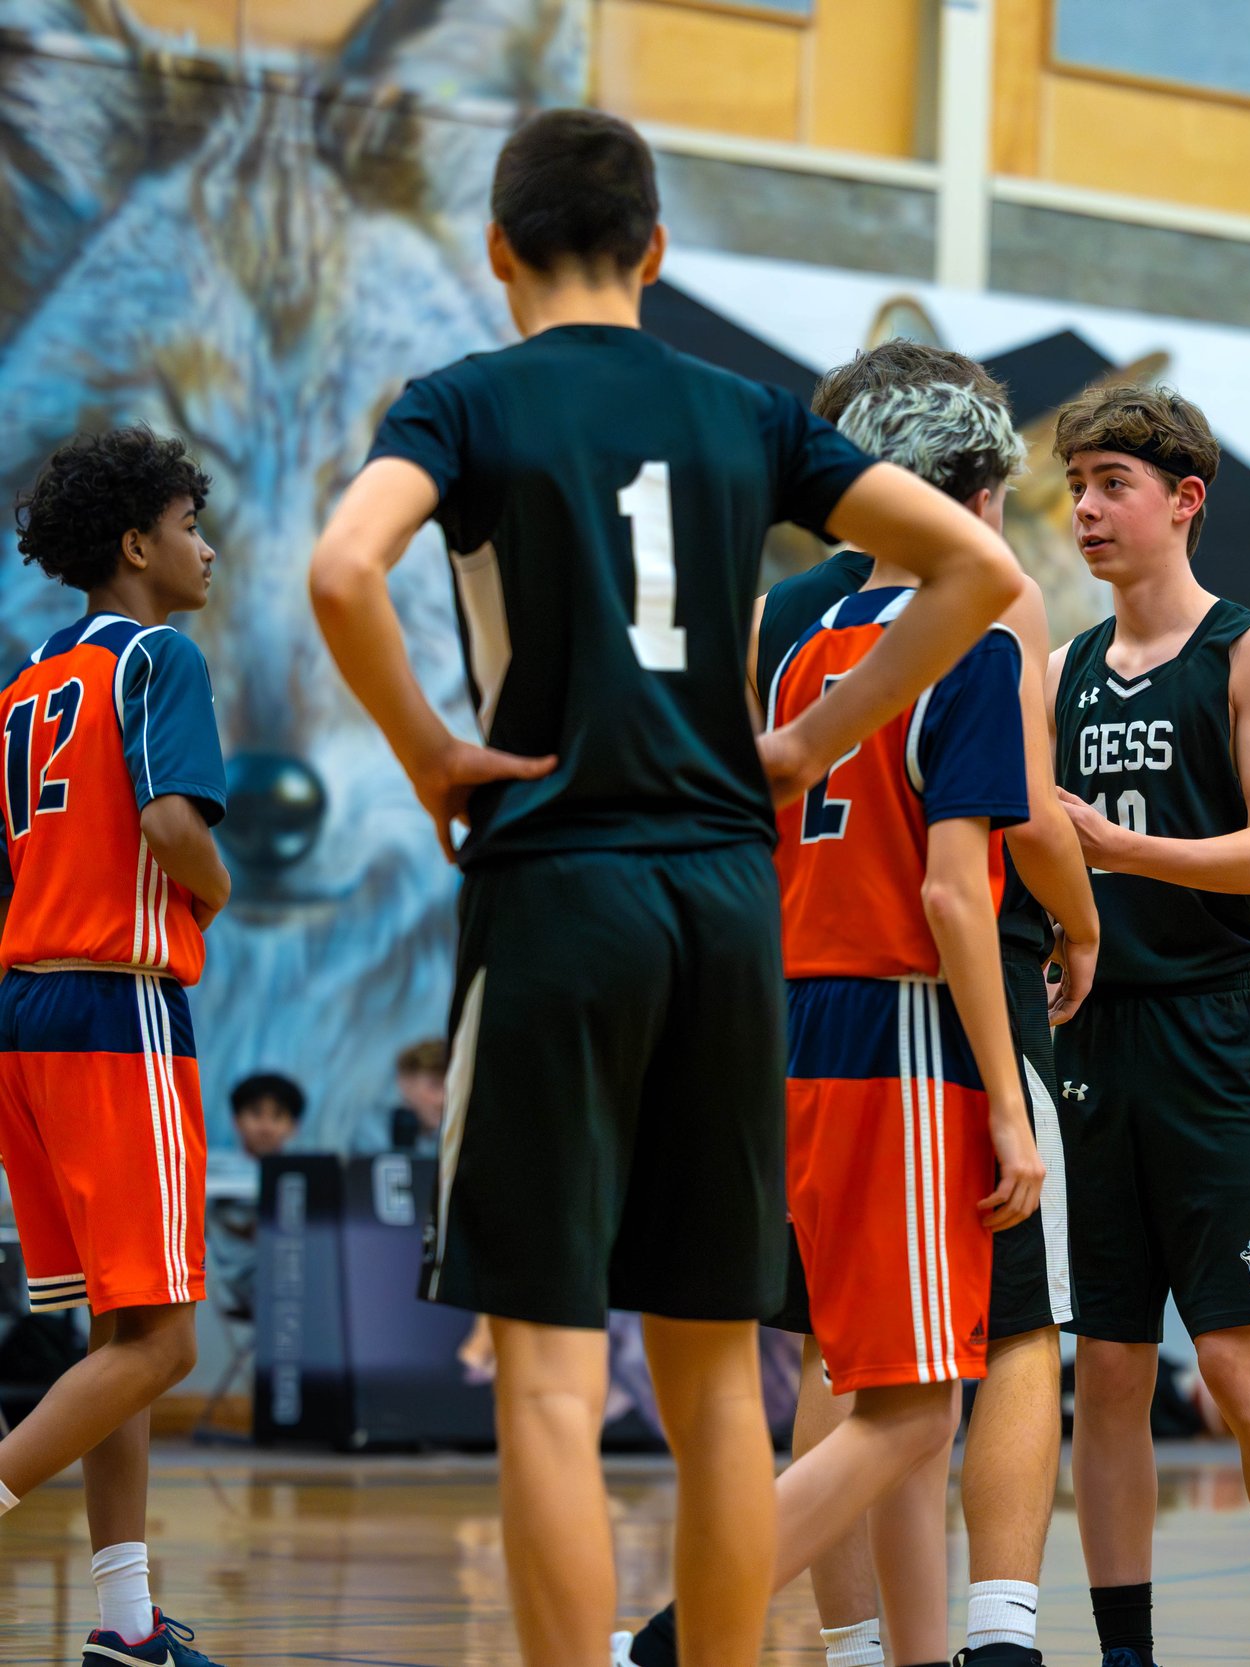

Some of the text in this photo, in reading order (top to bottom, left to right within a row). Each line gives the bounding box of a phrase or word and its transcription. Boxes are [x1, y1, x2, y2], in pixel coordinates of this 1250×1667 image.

[616, 460, 687, 672] 1
[3, 677, 84, 841] 12
[1080, 720, 1174, 776] GESS
